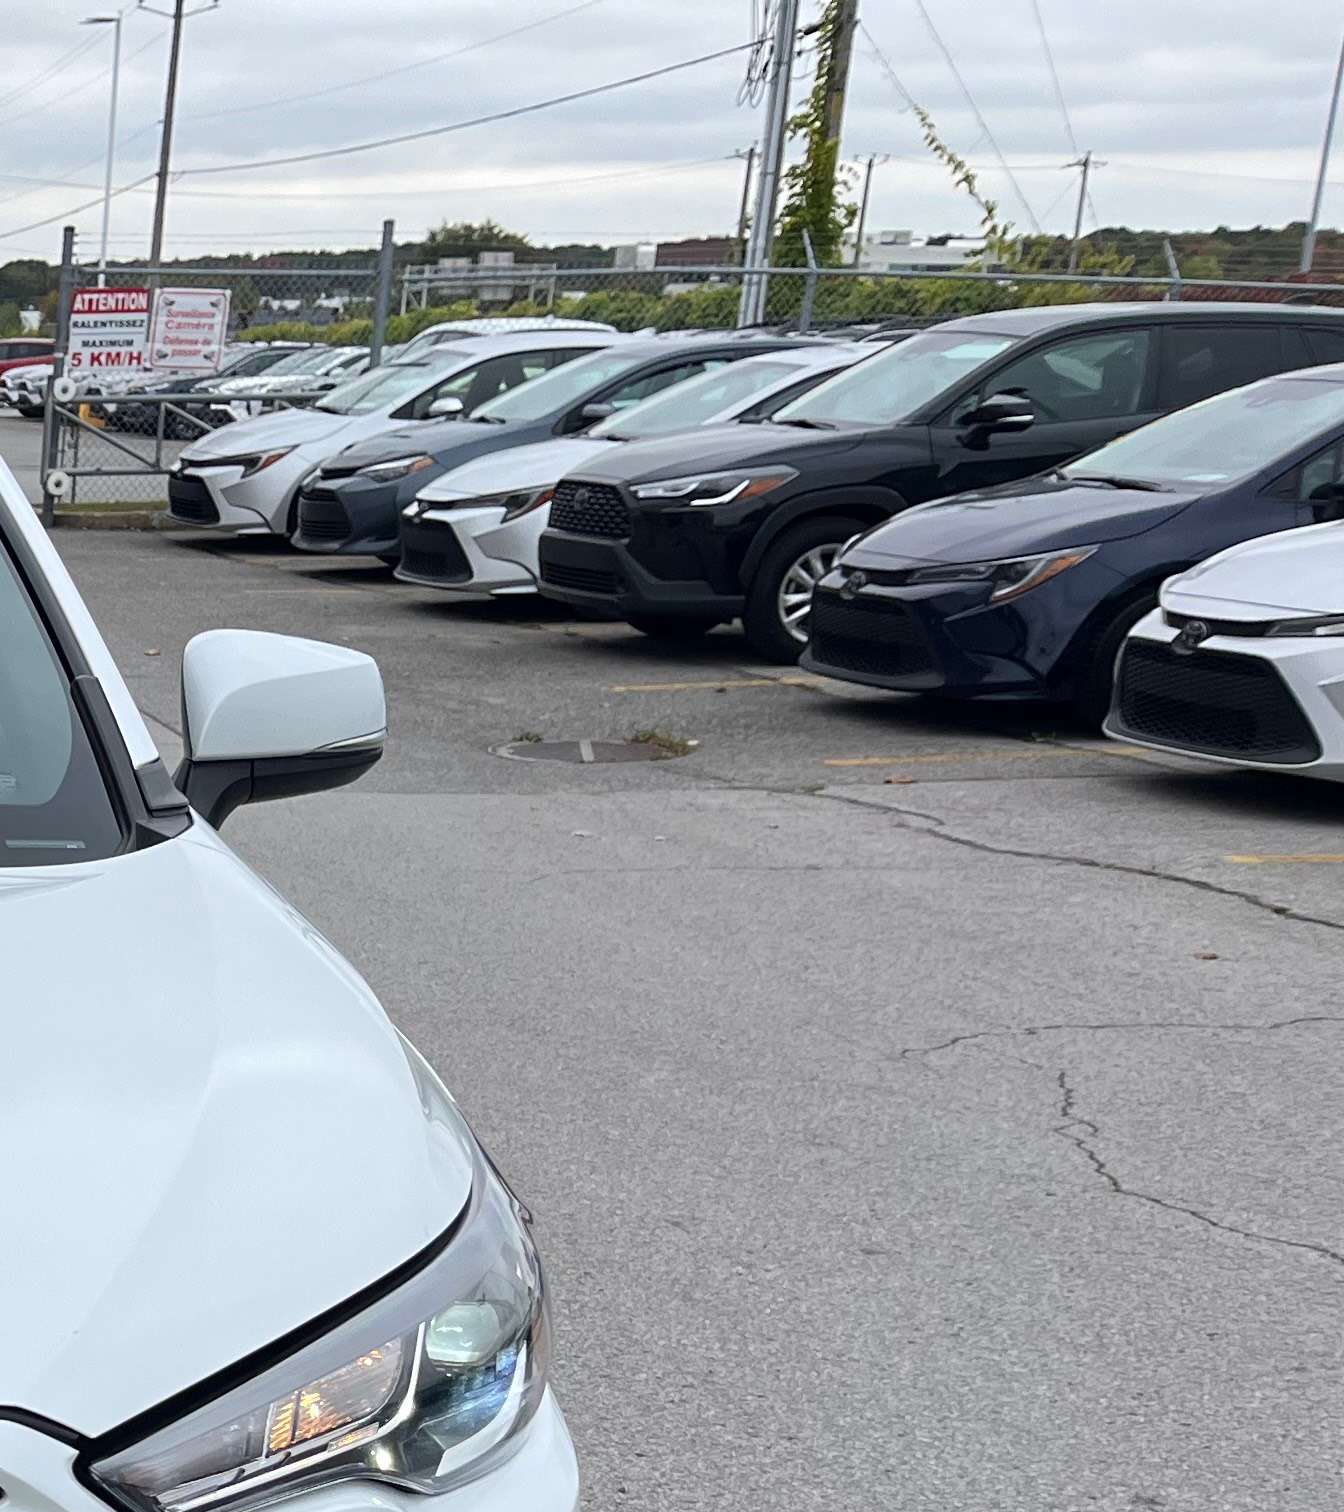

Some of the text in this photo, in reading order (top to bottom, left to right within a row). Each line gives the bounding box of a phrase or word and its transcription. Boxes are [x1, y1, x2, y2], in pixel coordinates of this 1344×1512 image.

[73, 292, 148, 311] ATTENTION
[72, 320, 145, 328] RALENTISSEZ
[81, 339, 134, 347] MAXIMUM
[72, 352, 142, 367] 5 KM/H
